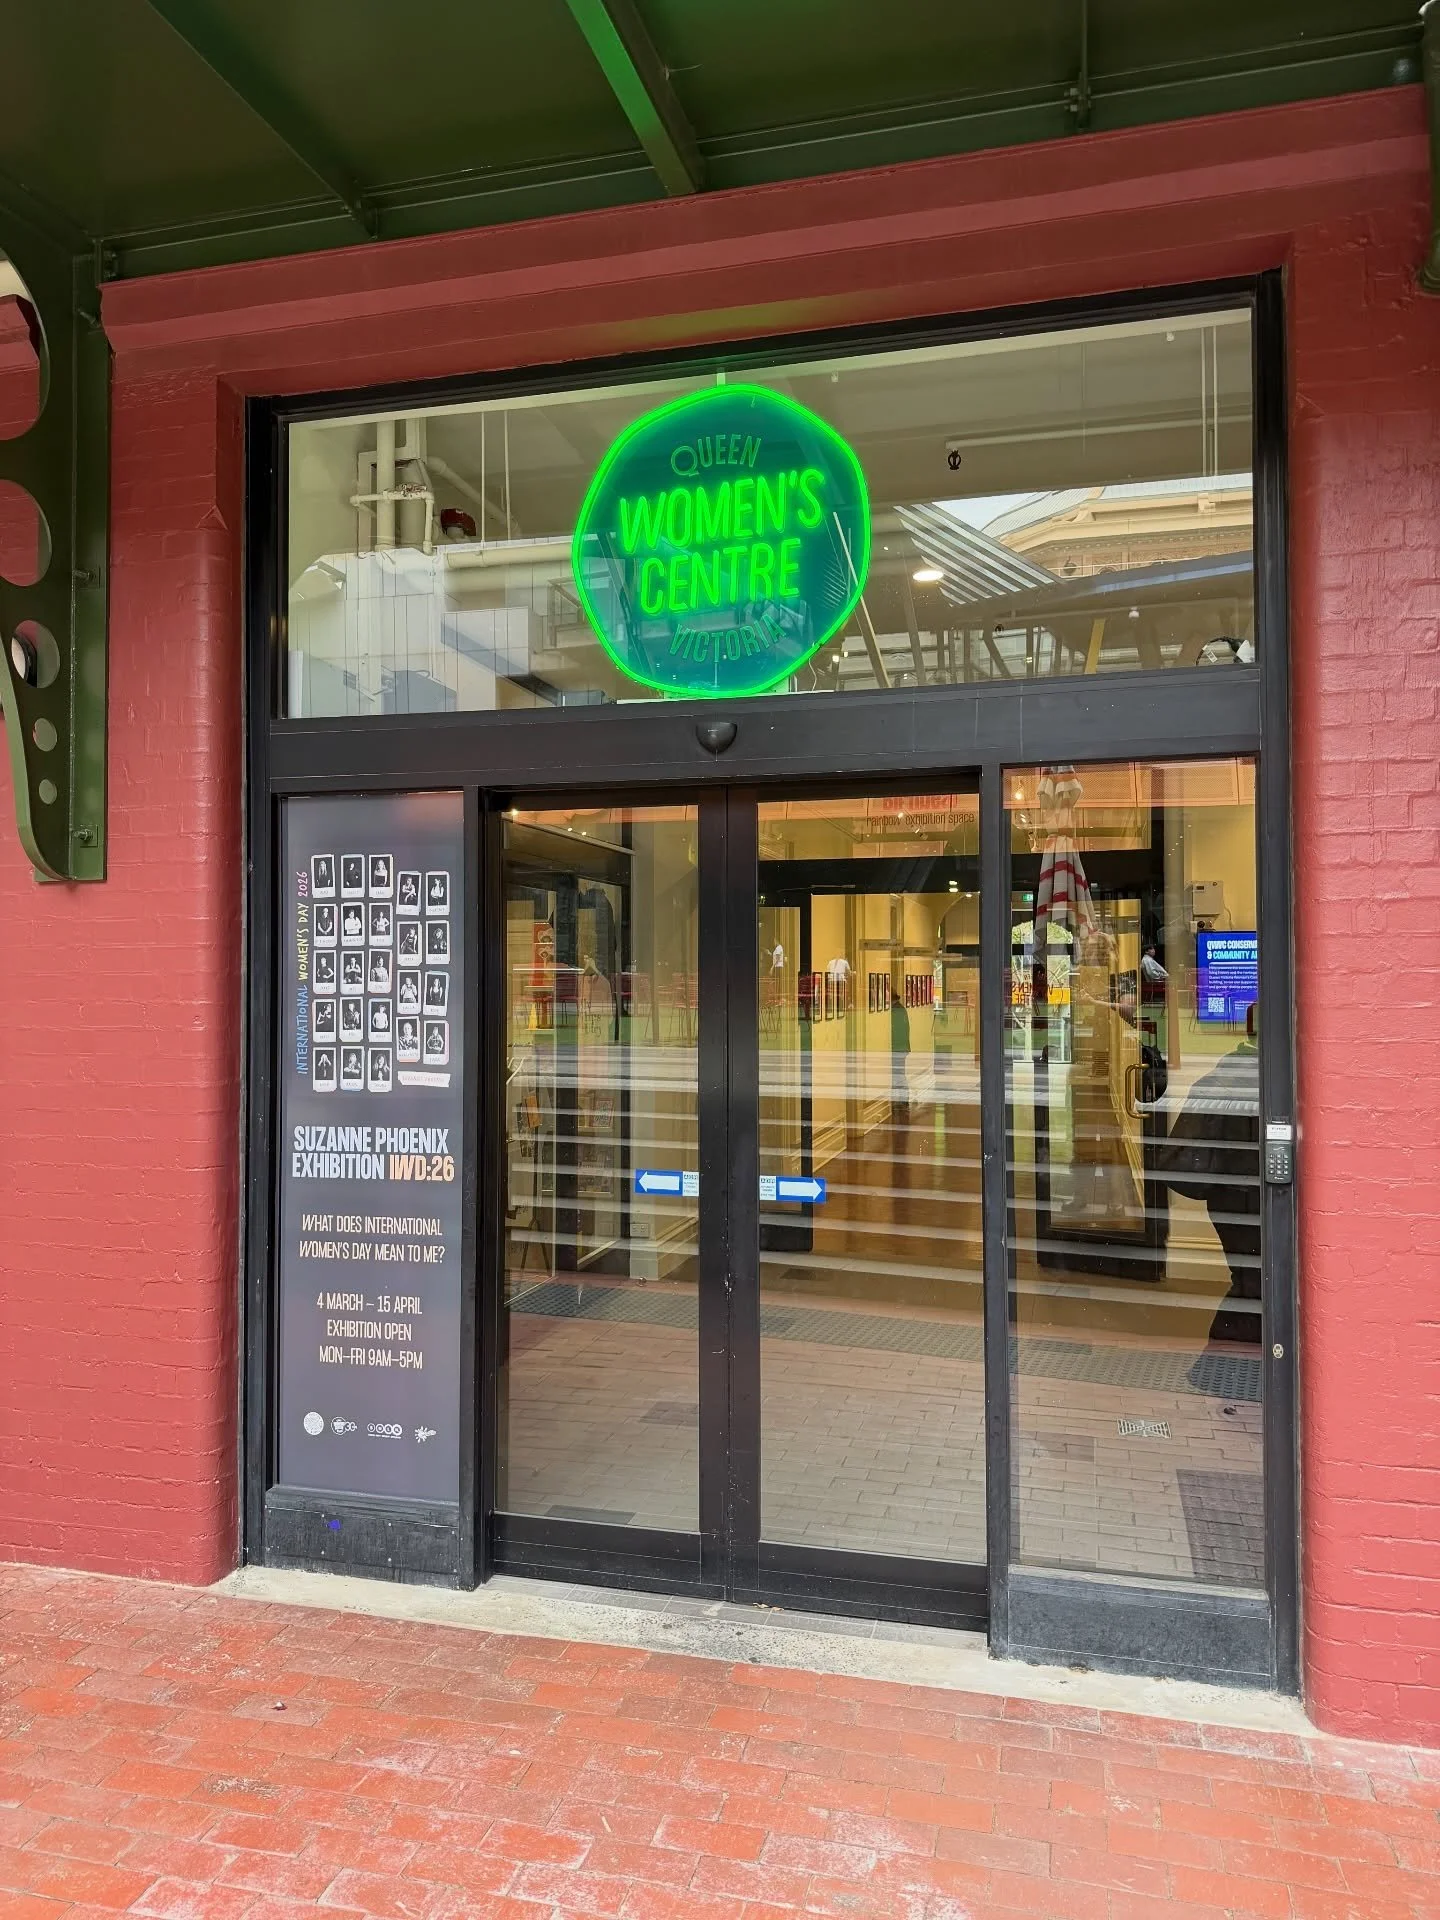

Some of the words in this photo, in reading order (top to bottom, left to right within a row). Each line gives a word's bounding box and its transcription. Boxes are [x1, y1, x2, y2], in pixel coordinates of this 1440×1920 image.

[670, 434, 761, 477] QUEEN
[619, 468, 825, 554] WOMEN'S
[640, 537, 801, 616] CENTRE
[669, 613, 787, 662] VICTORIA
[905, 813, 946, 825] exhibition
[948, 812, 975, 825] space
[296, 871, 309, 898] 2026
[298, 902, 309, 923] DAY
[297, 928, 309, 981] WOMEN'S
[1207, 950, 1212, 960] &
[1213, 950, 1250, 960] COMMUNITY
[295, 984, 309, 1075] INTERNATIONAL
[293, 1125, 372, 1152] SUZANNE
[375, 1127, 449, 1154] PHOENIX
[292, 1152, 385, 1179] EXHIBITION
[389, 1154, 455, 1181] IWD:26
[302, 1214, 333, 1232] WHAT
[336, 1215, 362, 1233] DOES
[365, 1216, 442, 1236] INTERNATIONAL
[299, 1240, 350, 1259] WOMEN'S
[352, 1242, 372, 1260] DAY
[374, 1243, 404, 1262] MEAN
[407, 1244, 420, 1262] TO
[423, 1245, 445, 1263] ME?
[316, 1292, 324, 1309] 4
[326, 1292, 363, 1311] MARCH
[377, 1295, 391, 1313] 15
[393, 1296, 423, 1315] APRIL
[327, 1319, 382, 1339] EXHIBITION
[384, 1322, 412, 1341] OPEN
